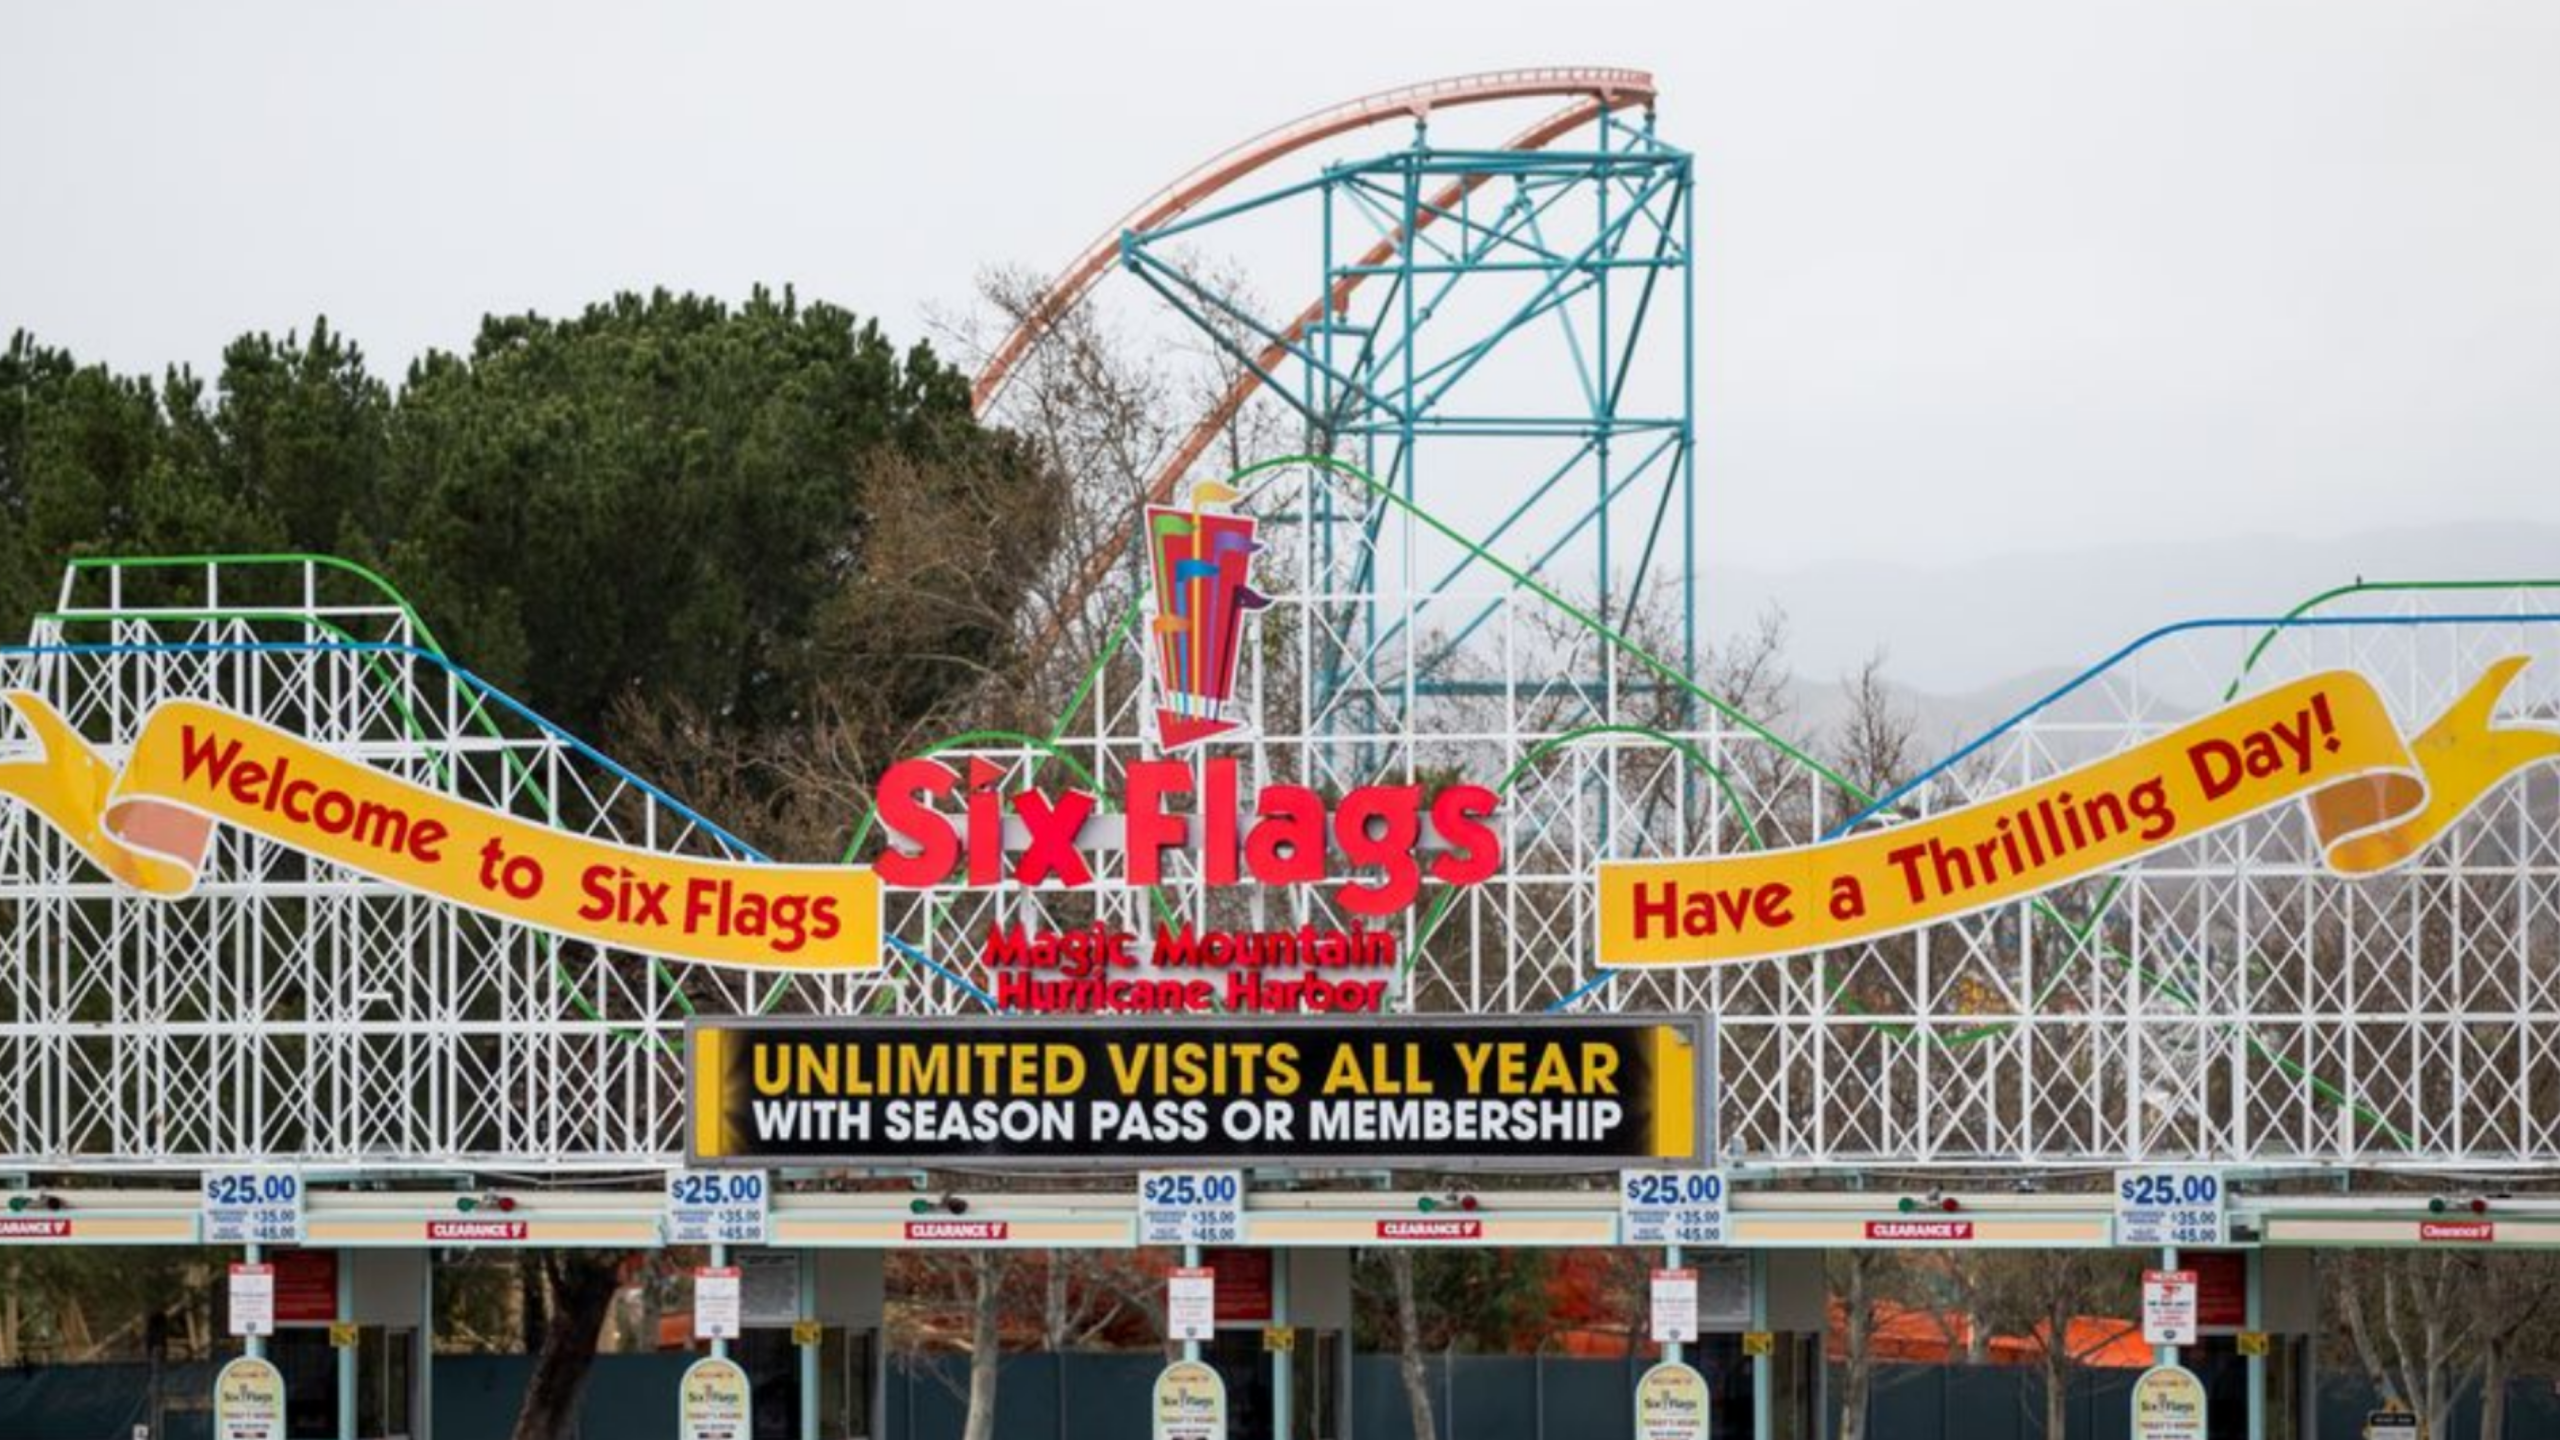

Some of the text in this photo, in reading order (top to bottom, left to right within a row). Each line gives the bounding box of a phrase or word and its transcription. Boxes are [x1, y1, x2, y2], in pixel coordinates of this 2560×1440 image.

[1633, 692, 2342, 940] Have a Thrilling Day!
[181, 724, 840, 953] Welcome to Six Flags
[871, 755, 1503, 919] Six Flags
[982, 918, 1397, 976] Magic Mountain
[998, 969, 1388, 1013] Hurricane Harbor
[754, 1042, 1619, 1096] UNLIMITED VISITS ALL YEAR
[752, 1099, 1622, 1141] WITH SEASON PASS OR MEMBERSHIP
[208, 1175, 295, 1204] $25.00
[672, 1175, 761, 1204] $25.00
[1144, 1175, 1236, 1204] $25.00
[1627, 1175, 1720, 1204] $25.00
[2121, 1175, 2217, 1204] $25.00
[434, 1223, 507, 1237] CLEARANCE
[912, 1224, 988, 1237] CLEARANCE
[1384, 1221, 1460, 1235] CLEARANCE
[1873, 1222, 1952, 1236] CLEARANCE
